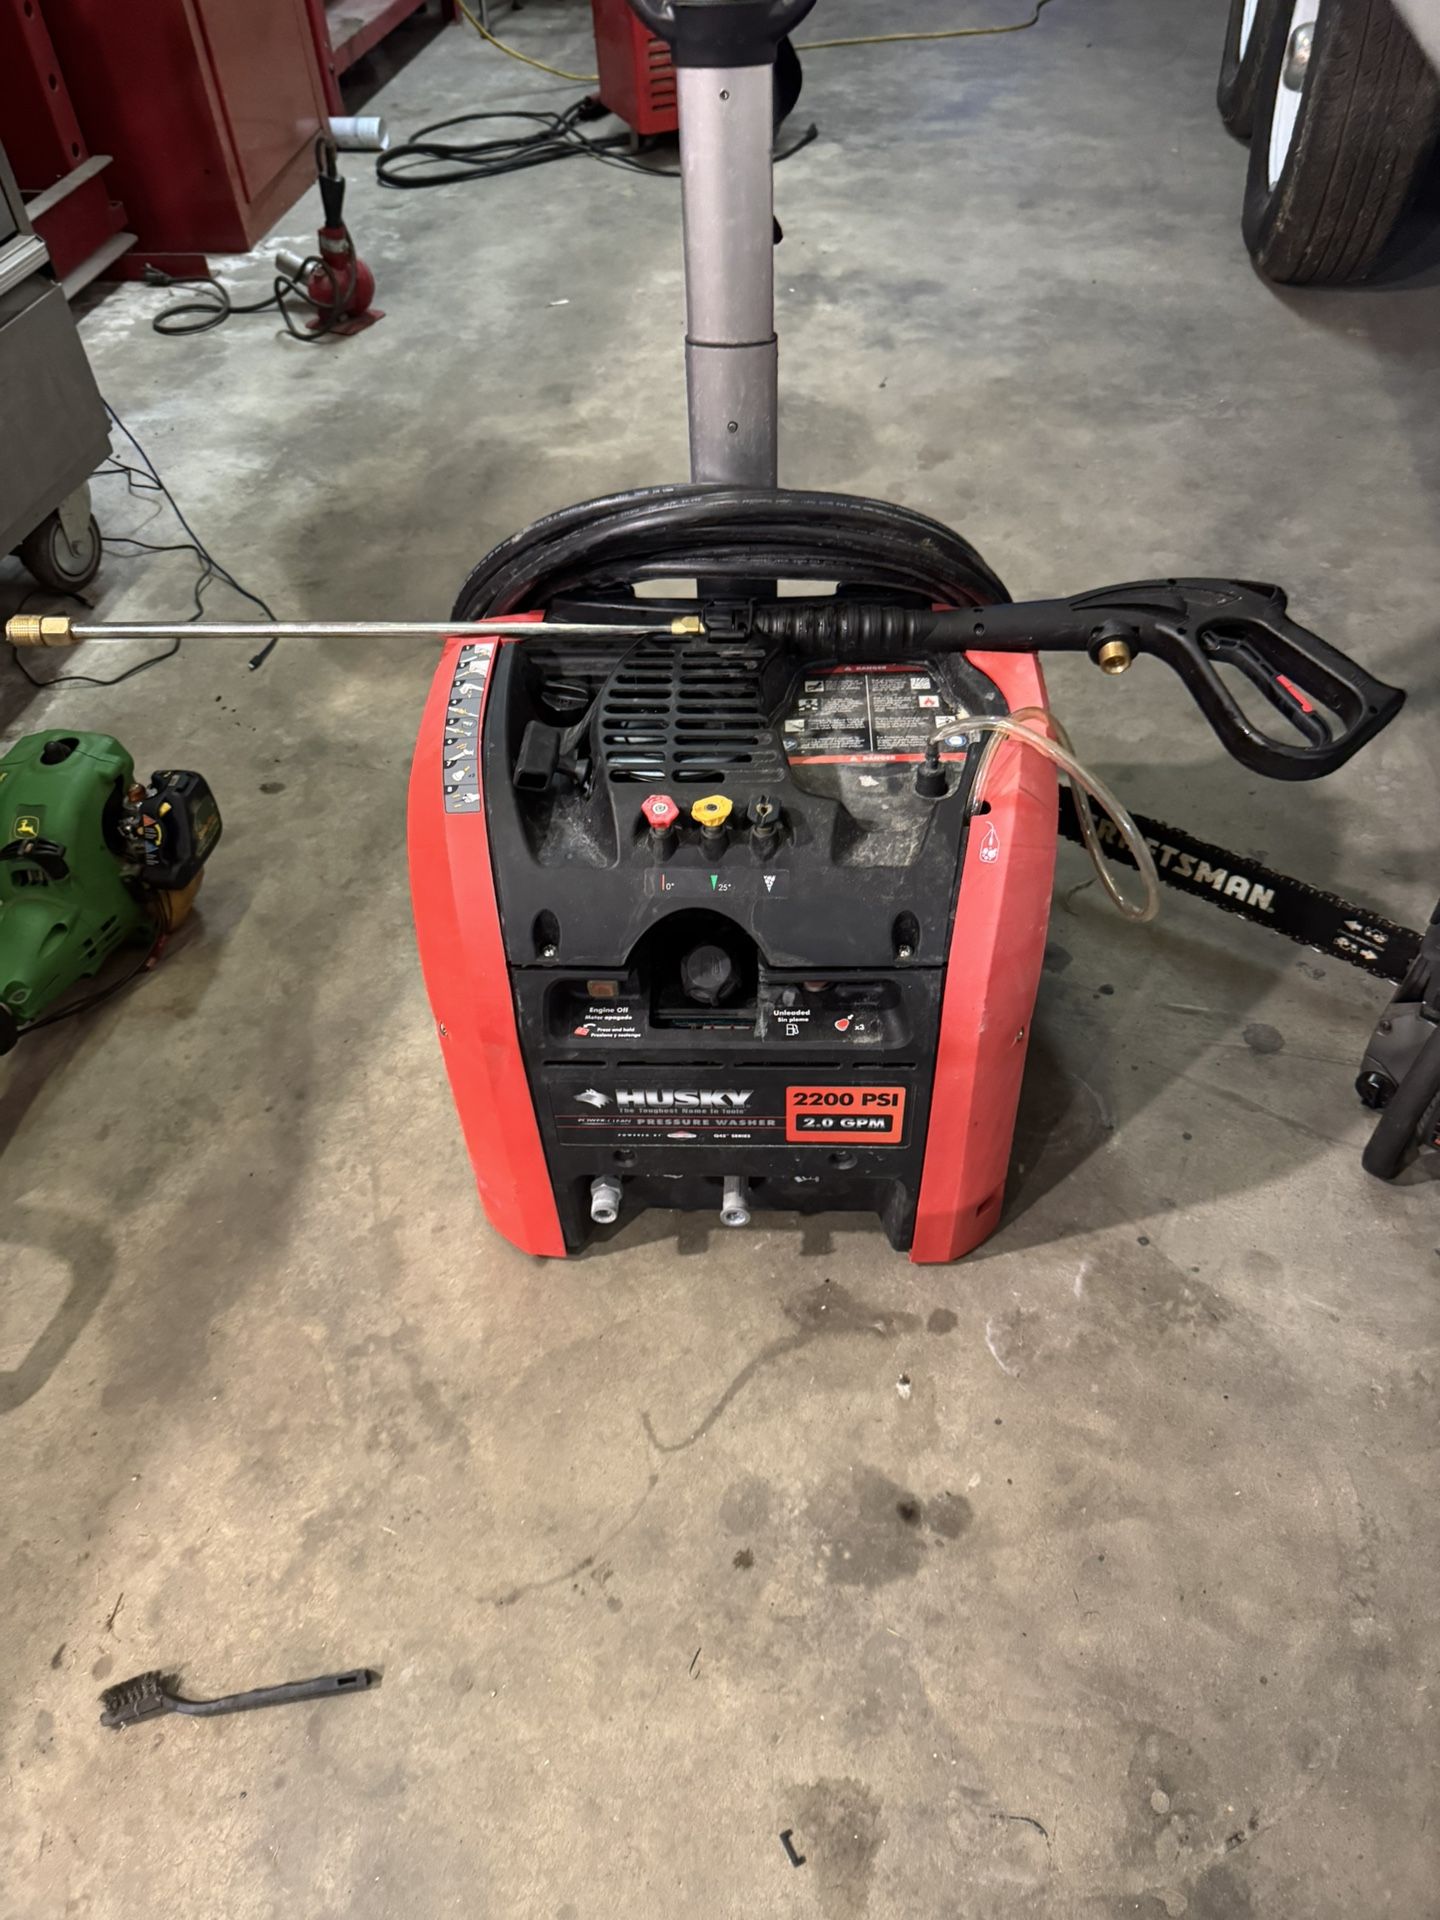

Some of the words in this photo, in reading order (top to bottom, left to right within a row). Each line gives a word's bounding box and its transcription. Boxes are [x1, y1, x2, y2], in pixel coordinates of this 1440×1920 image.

[589, 1007, 615, 1015] Engine
[854, 1023, 865, 1031] x3
[615, 1088, 754, 1109] HUSKY
[793, 1092, 854, 1106] 2200
[861, 1093, 899, 1107] PSI
[637, 1118, 710, 1126] PRESSURE
[803, 1117, 834, 1128] 2.0
[840, 1117, 886, 1129] GPM
